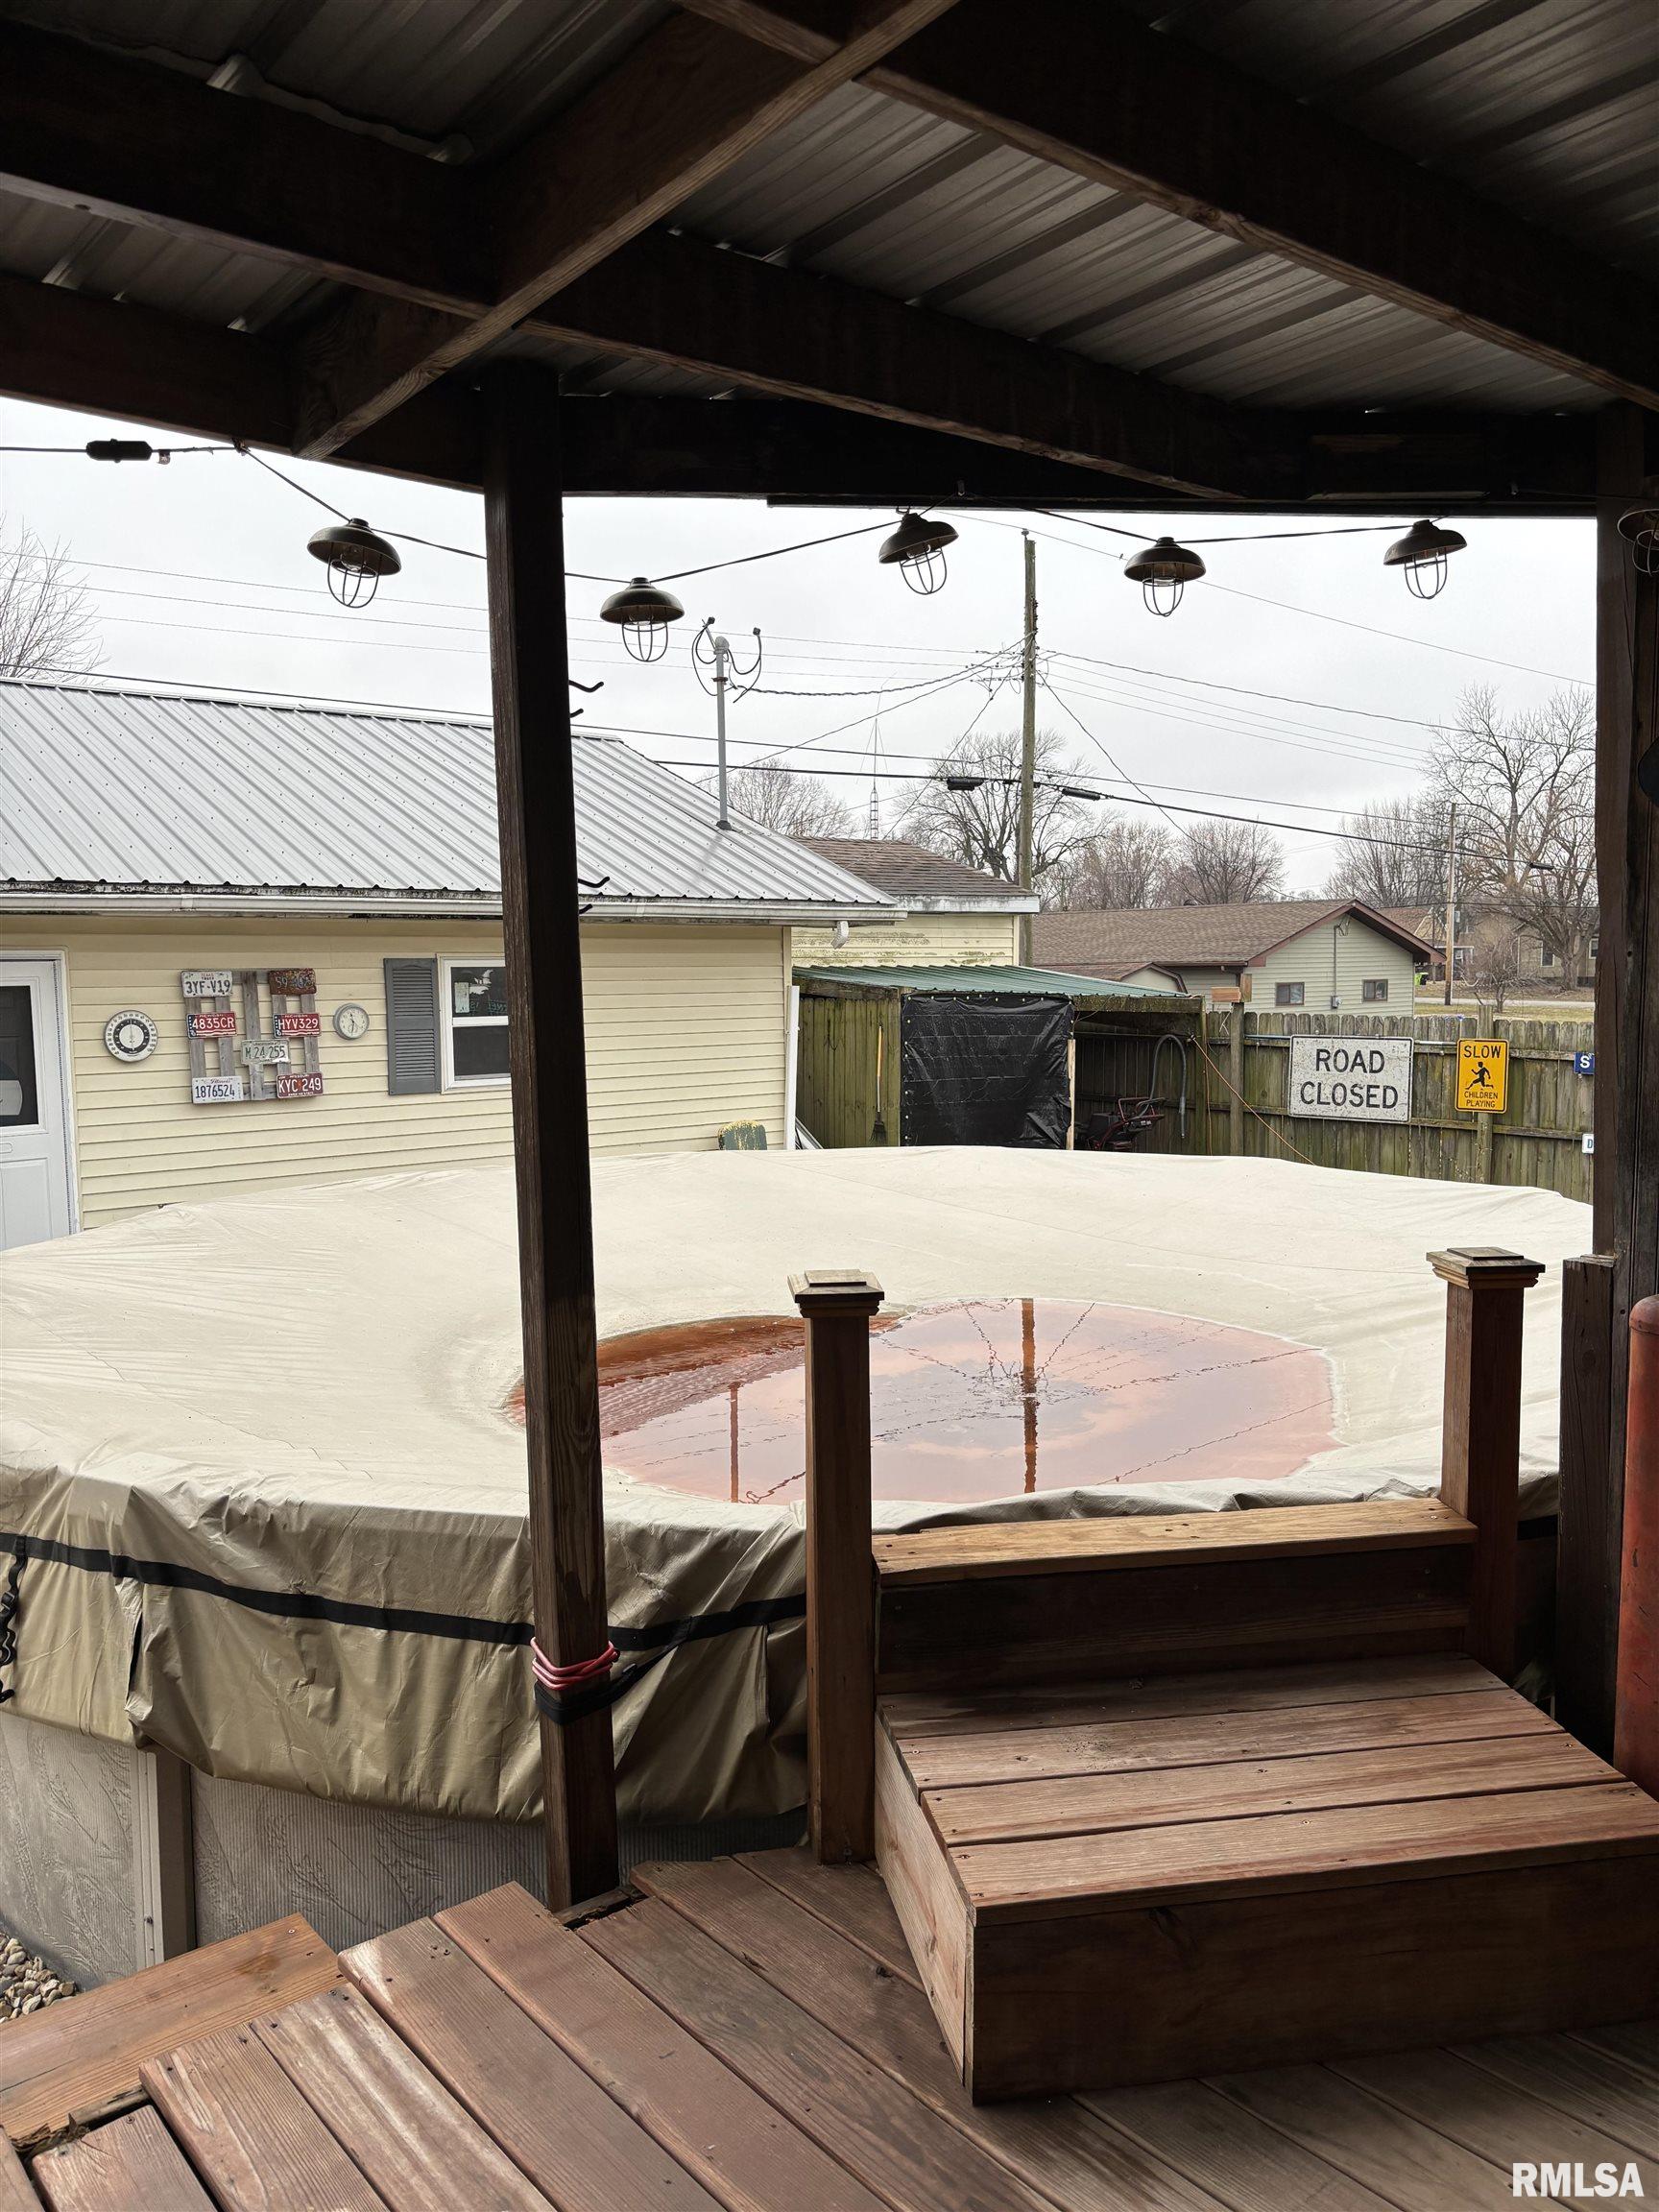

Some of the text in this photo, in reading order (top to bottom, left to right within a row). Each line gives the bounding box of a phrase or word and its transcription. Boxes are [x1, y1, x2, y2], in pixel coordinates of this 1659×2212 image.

[185, 979, 230, 995] 3YF-V19
[192, 1017, 235, 1030] 4835CR
[277, 1018, 319, 1030] HYV329
[269, 1045, 286, 1059] 255
[1463, 1045, 1502, 1059] SLOW
[1315, 1048, 1385, 1074] ROAD
[195, 1084, 235, 1099] 1876524
[277, 1077, 322, 1094] KYC 249
[1300, 1081, 1399, 1109] CLOSED
[1464, 1091, 1499, 1099] CHILDREN
[1466, 1099, 1496, 1108] PLAYING
